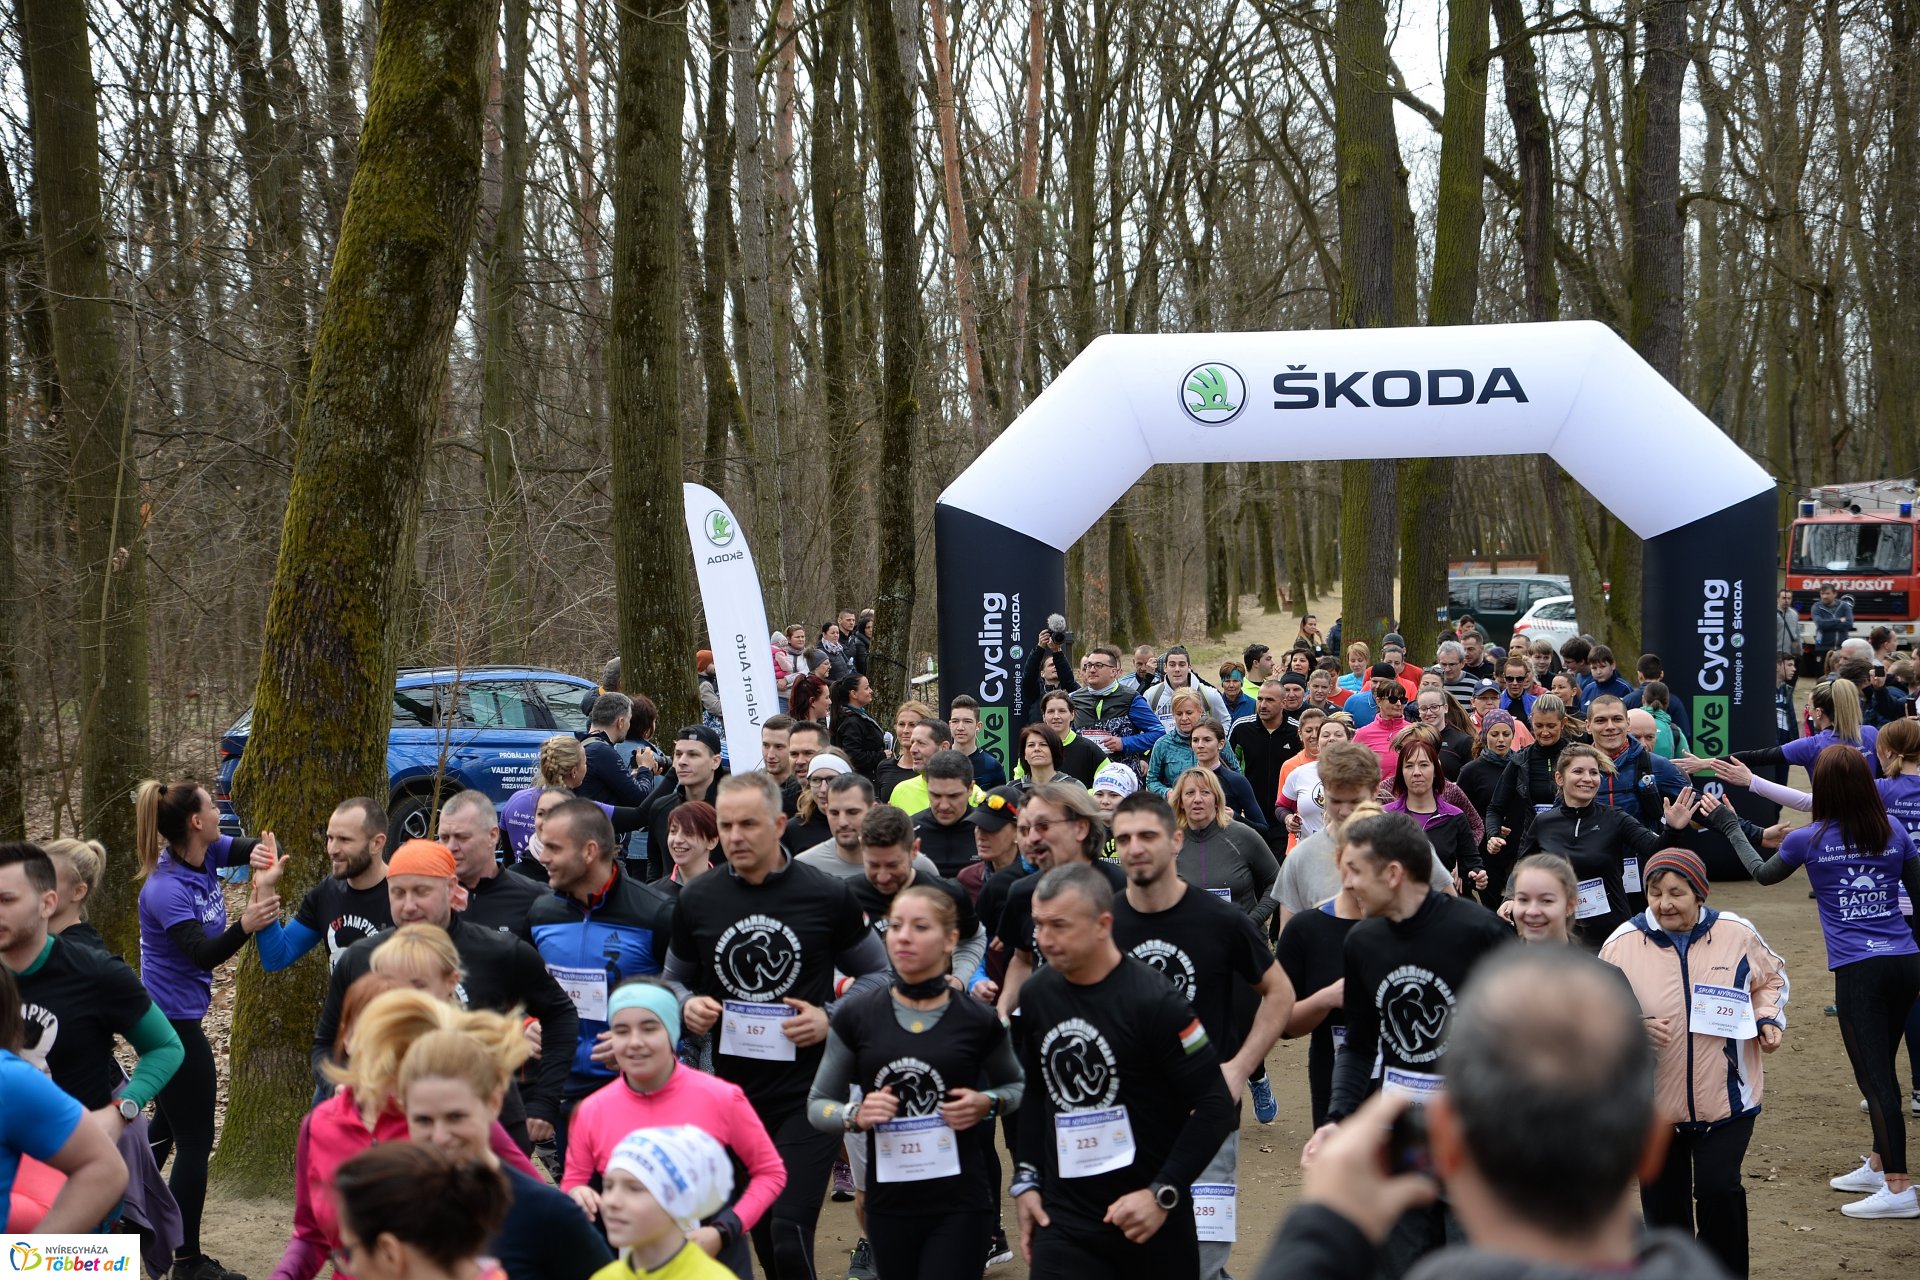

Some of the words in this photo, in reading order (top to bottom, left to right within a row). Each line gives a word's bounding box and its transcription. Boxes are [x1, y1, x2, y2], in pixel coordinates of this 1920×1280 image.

[1273, 364, 1530, 410] ŠKODA
[1732, 579, 1743, 629] ŠKODA
[1011, 592, 1020, 642] ŠKODA
[1697, 579, 1730, 691] Cycling
[978, 592, 1008, 703] Cycling
[1733, 659, 1744, 705] Hajtóereje
[1013, 670, 1024, 716] Hajtóereje
[1696, 702, 1724, 757] ove
[491, 766, 518, 774] VALENT
[519, 766, 539, 774] AUTÓ
[1817, 854, 1847, 863] Jótékony
[1839, 890, 1888, 908] BÁTOR
[1839, 903, 1887, 919] TÁBOR
[1697, 987, 1716, 996] SPURI
[1716, 1005, 1734, 1017] 229
[746, 1025, 766, 1035] 167
[900, 1142, 922, 1154] 221
[1075, 1137, 1099, 1150] 223
[1195, 1206, 1215, 1216] 289
